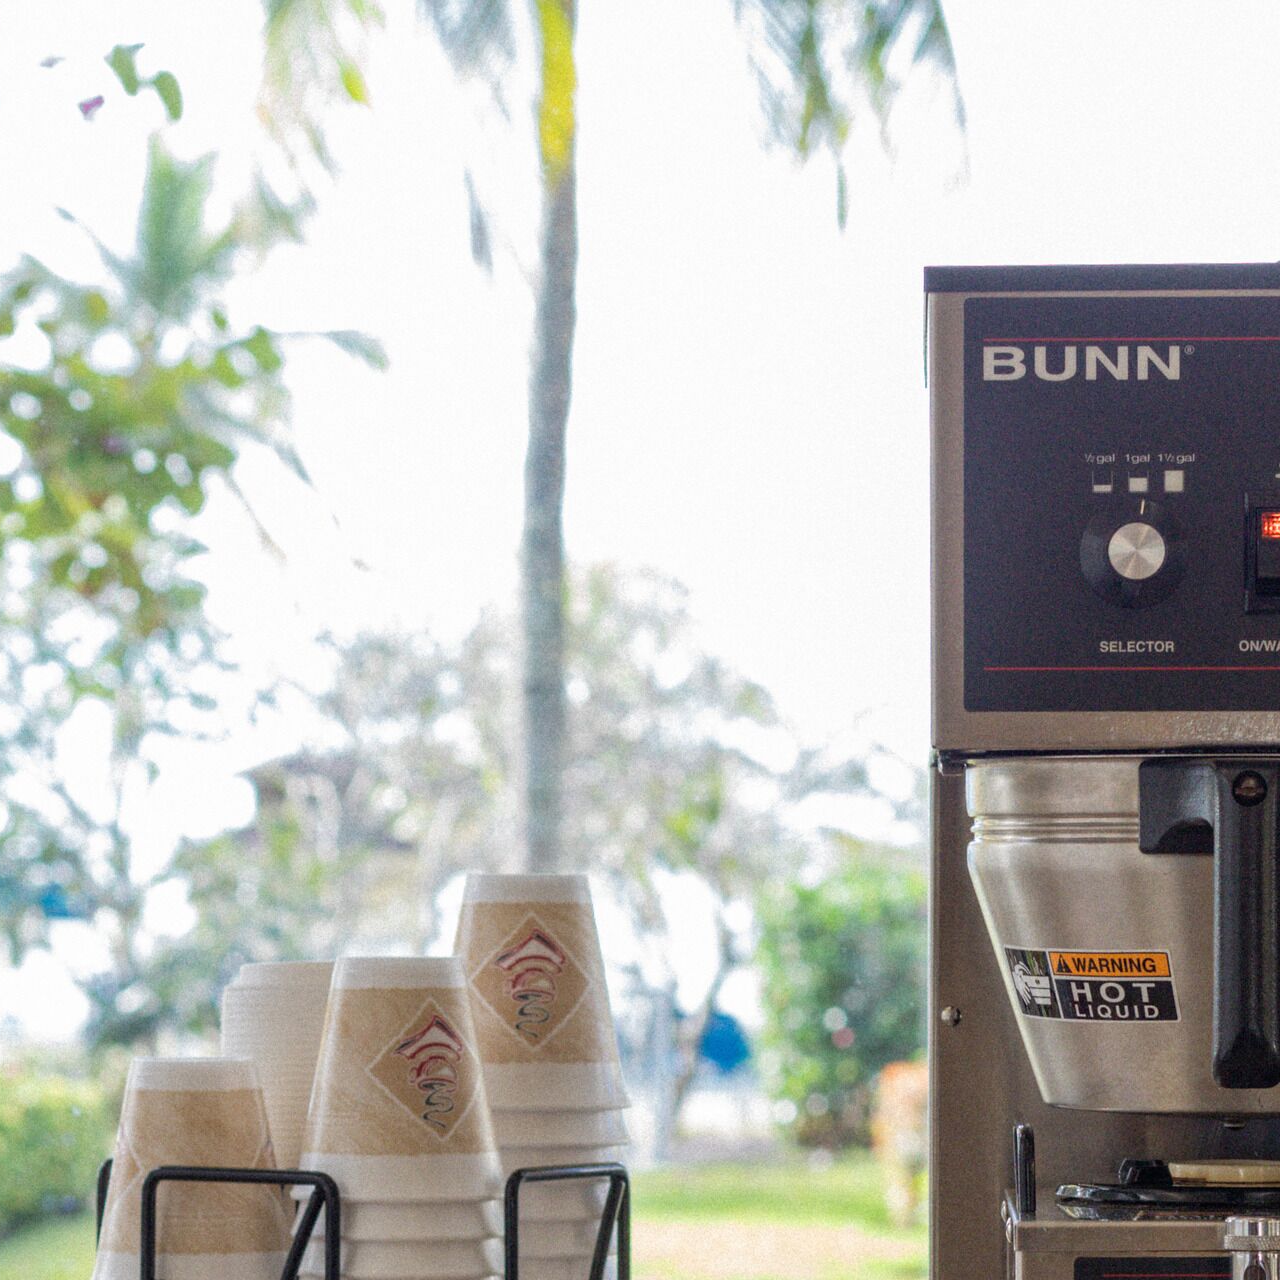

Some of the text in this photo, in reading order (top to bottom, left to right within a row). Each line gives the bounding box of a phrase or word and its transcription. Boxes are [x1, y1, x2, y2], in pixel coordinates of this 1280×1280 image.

[1096, 453, 1116, 464] gal
[1176, 453, 1196, 464] gal
[1099, 639, 1175, 653] SELECTOR
[1072, 957, 1156, 973] WARNING
[1070, 981, 1155, 1003] HOT
[1075, 1003, 1159, 1019] LIQUID
